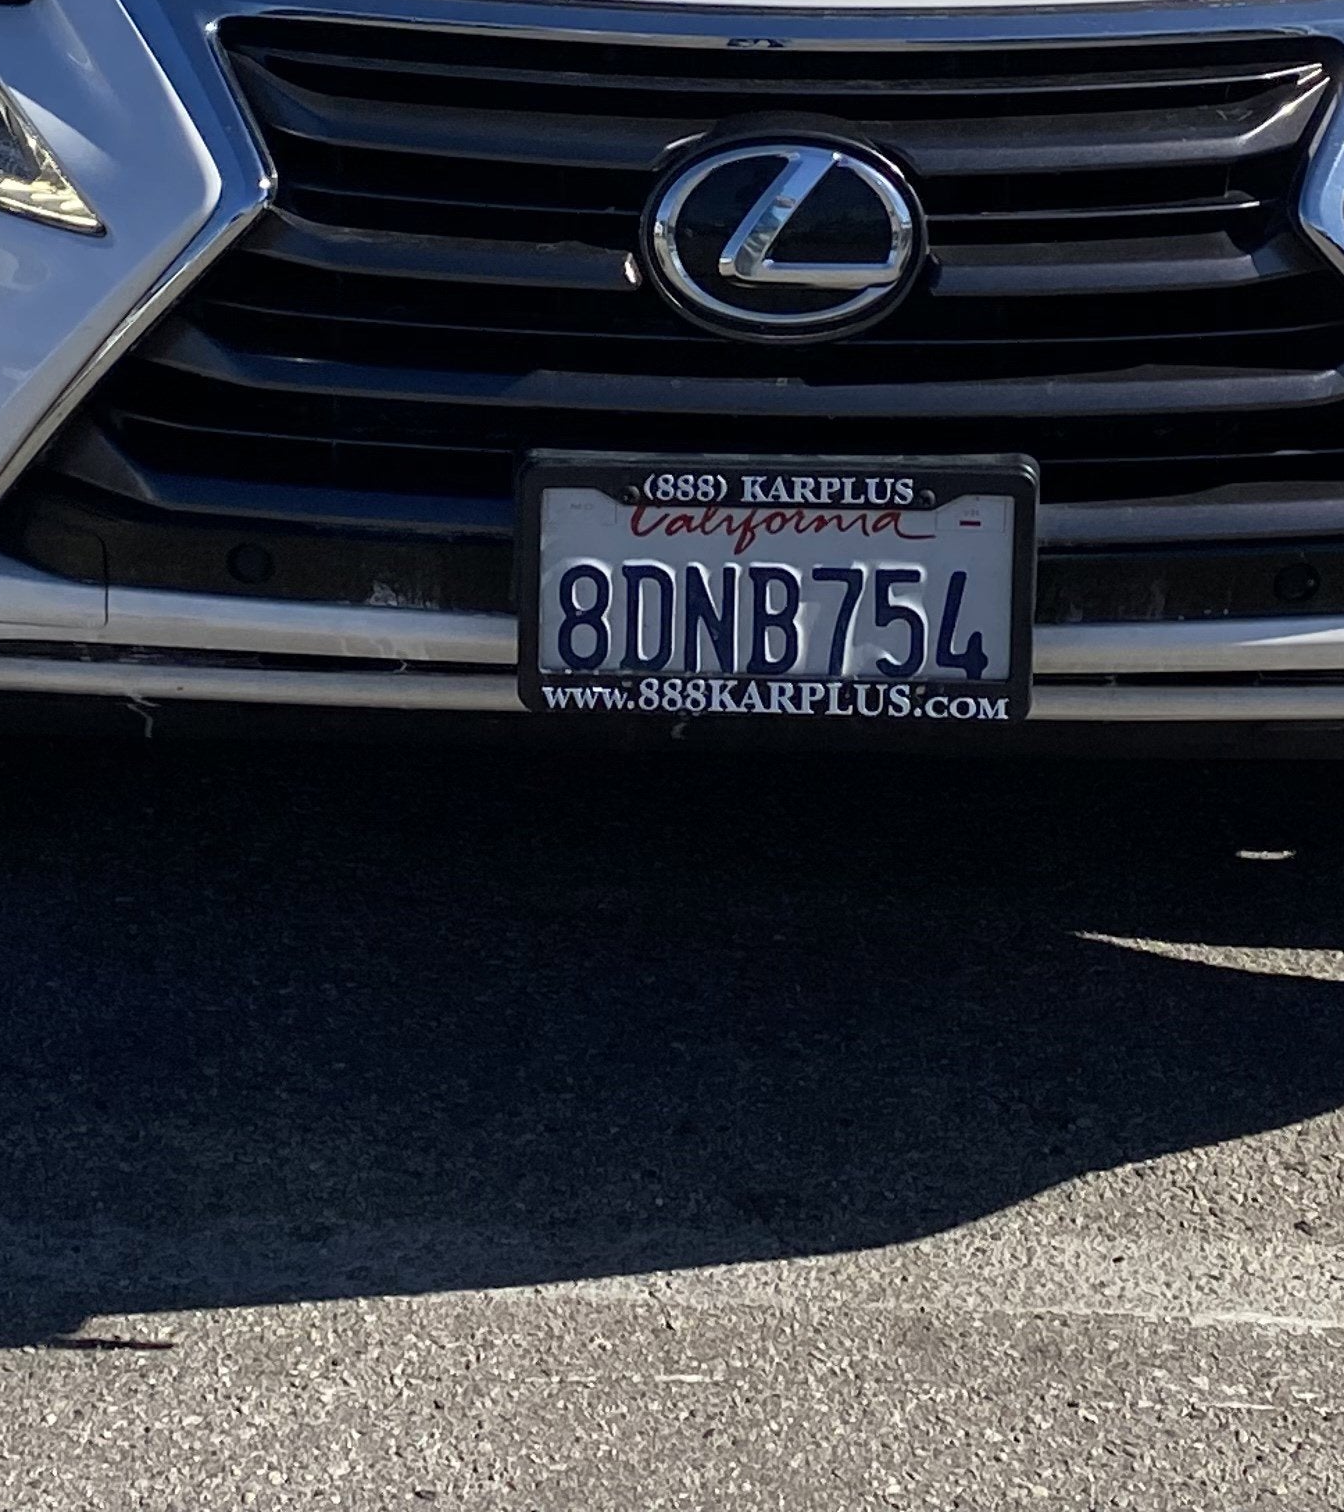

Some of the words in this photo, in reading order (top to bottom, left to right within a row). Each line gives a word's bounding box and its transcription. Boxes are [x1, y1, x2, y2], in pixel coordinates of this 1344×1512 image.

[643, 473, 727, 502] (888)
[740, 475, 914, 505] KARPLUS
[630, 504, 937, 555] California
[557, 564, 990, 681] 8DNB754
